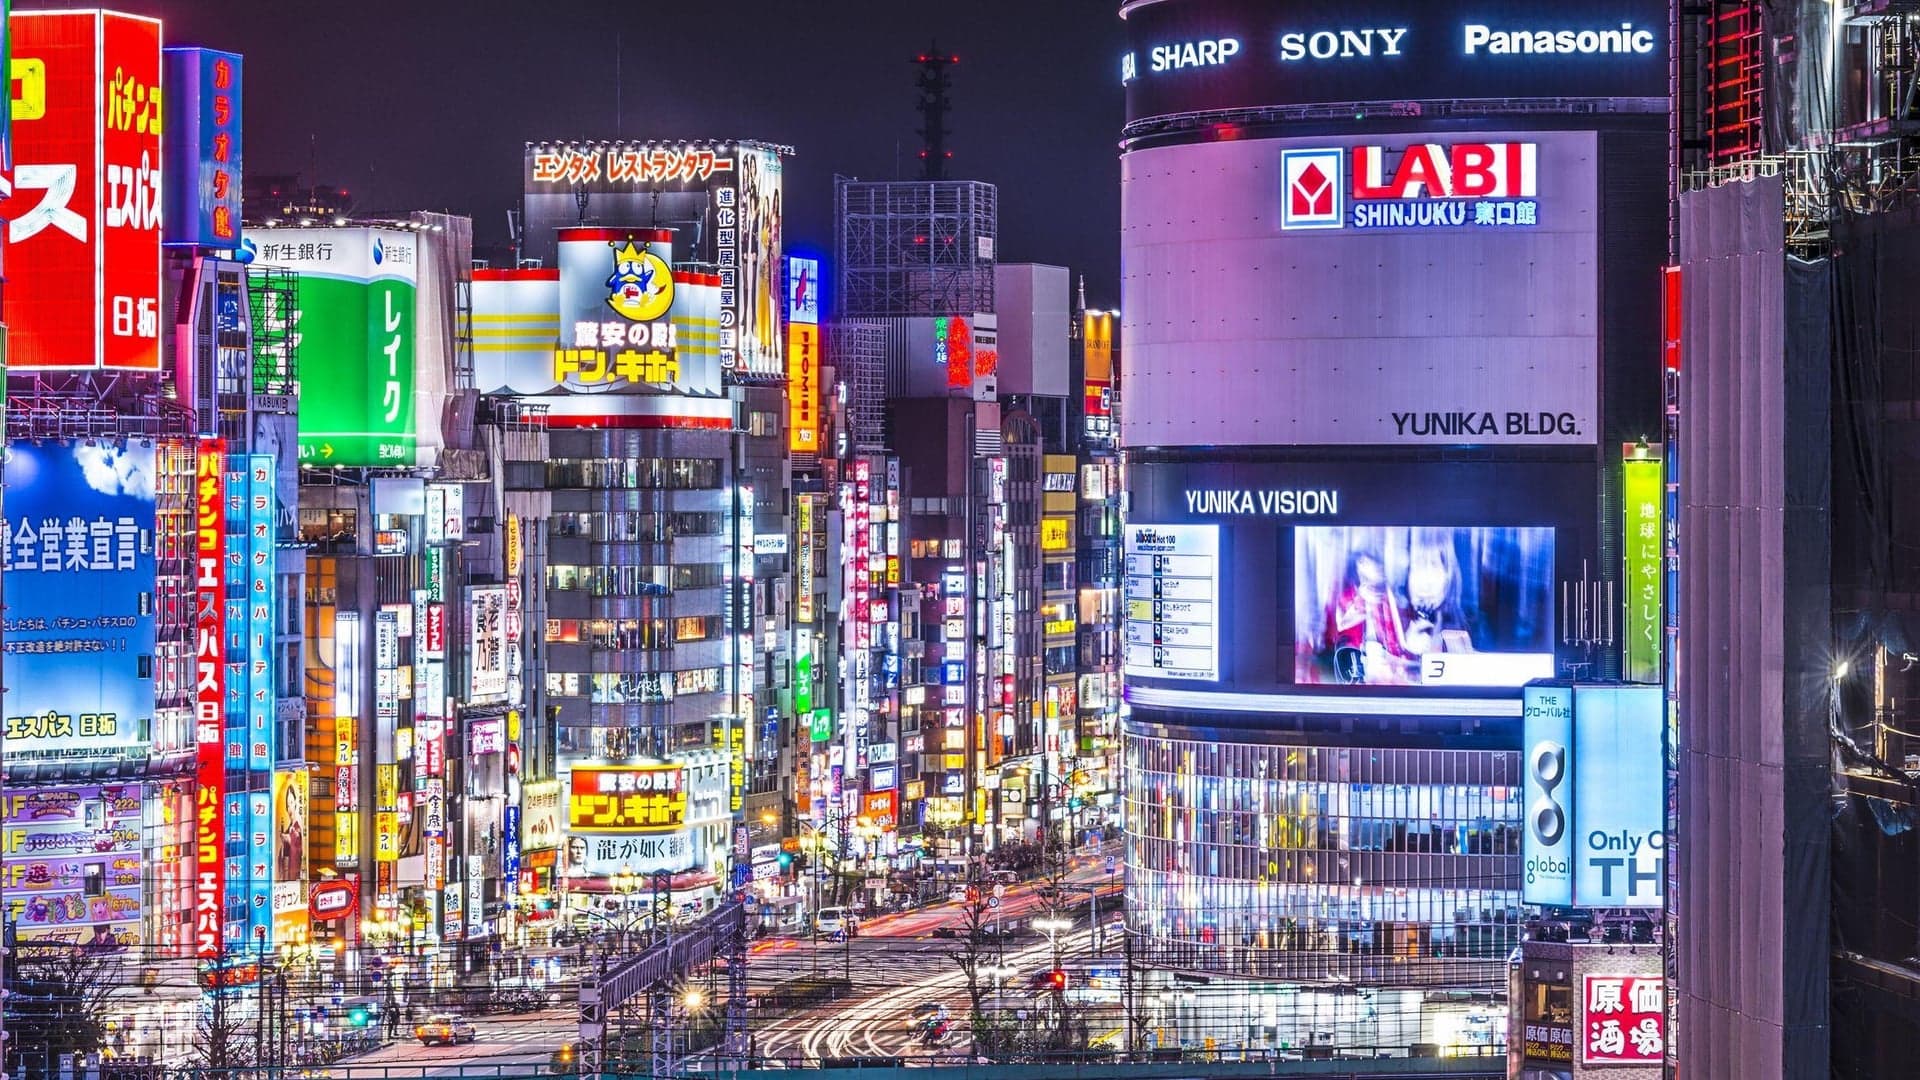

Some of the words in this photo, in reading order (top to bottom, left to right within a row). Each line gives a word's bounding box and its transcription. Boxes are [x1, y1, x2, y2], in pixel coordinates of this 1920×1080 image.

[1151, 38, 1239, 72] SHARP
[1281, 28, 1407, 61] SONY
[1464, 22, 1654, 55] Panasonic
[107, 66, 162, 135] パチンコ
[214, 60, 233, 238] カラオケ館
[533, 150, 601, 184] エンタメ
[606, 150, 734, 184] レストランタワー
[1352, 143, 1537, 199] LABI
[106, 150, 162, 231] エスパス
[1353, 201, 1466, 227] SHINJUKU
[1474, 201, 1537, 226] 東口館
[263, 242, 333, 261] 新生銀行
[384, 245, 412, 265] 新生銀行
[112, 295, 158, 338] 日拓
[383, 290, 401, 424] レイク
[1391, 411, 1500, 436] YUNIKA
[1505, 411, 1582, 436] BLDG.
[198, 451, 219, 550] パチンコ
[1186, 490, 1255, 514] YUNIKA
[1259, 490, 1338, 514] VISION
[1639, 502, 1657, 650] 地球にやさしく。
[197, 557, 219, 693] エスパス
[1428, 660, 1446, 678] 3
[619, 678, 661, 695] FLARE
[1539, 696, 1557, 705] THE
[6, 710, 73, 740] エスパス
[79, 712, 117, 736] 日拓
[197, 701, 219, 744] 日拓
[1525, 706, 1571, 719] グローバル社
[198, 785, 218, 865] パチンコ
[596, 839, 666, 861] 龍が如く
[1588, 829, 1642, 856] Only
[1527, 855, 1570, 884] global
[197, 872, 218, 952] エスパス
[1589, 978, 1664, 1014] 原価
[1525, 1025, 1548, 1042] 原価
[1550, 1027, 1573, 1045] 原価
[1590, 1017, 1664, 1056] 酒場
